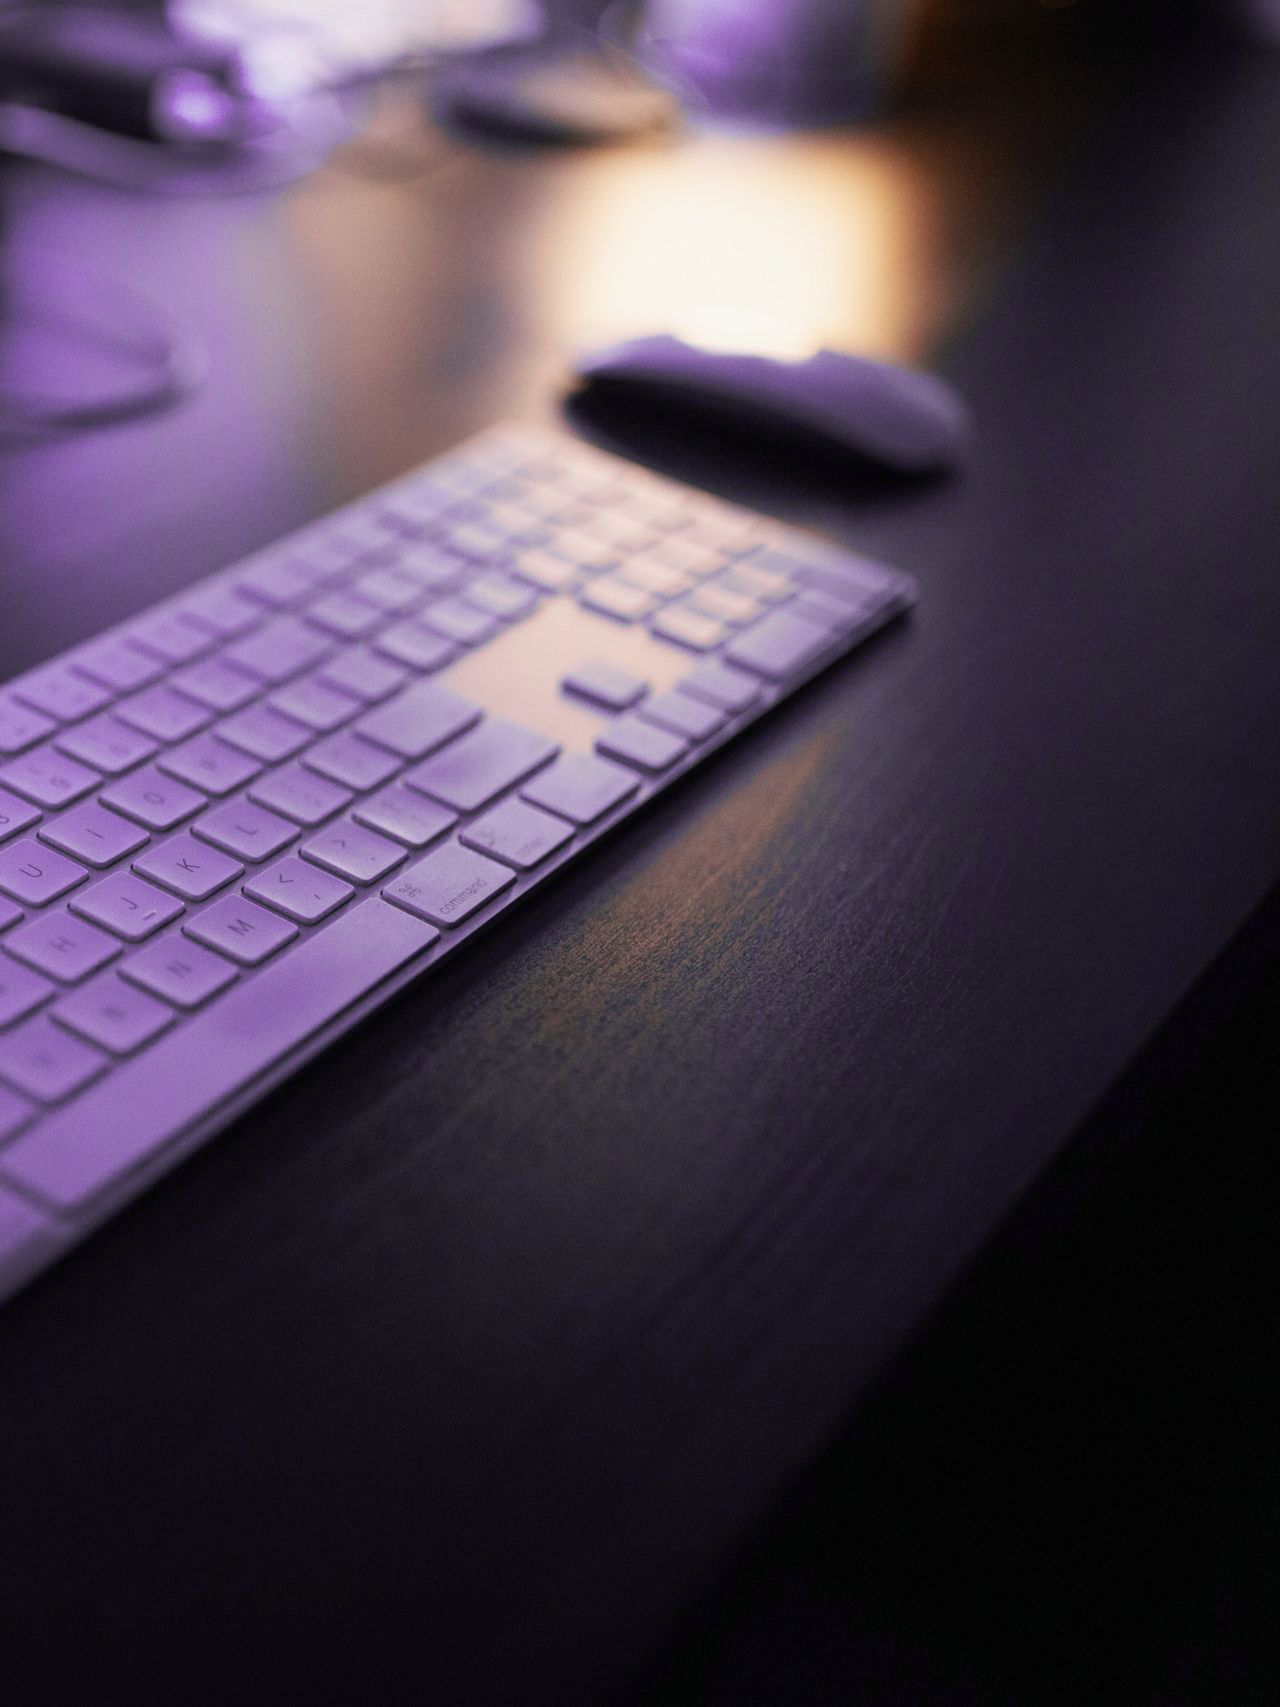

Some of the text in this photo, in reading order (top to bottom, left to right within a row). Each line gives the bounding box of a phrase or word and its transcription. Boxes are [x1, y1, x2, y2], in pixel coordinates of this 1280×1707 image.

[235, 825, 259, 836] L
[19, 863, 43, 878] U
[176, 858, 201, 873] K
[279, 873, 294, 884] <
[121, 896, 138, 910] J
[438, 878, 488, 916] command
[227, 918, 256, 936] M
